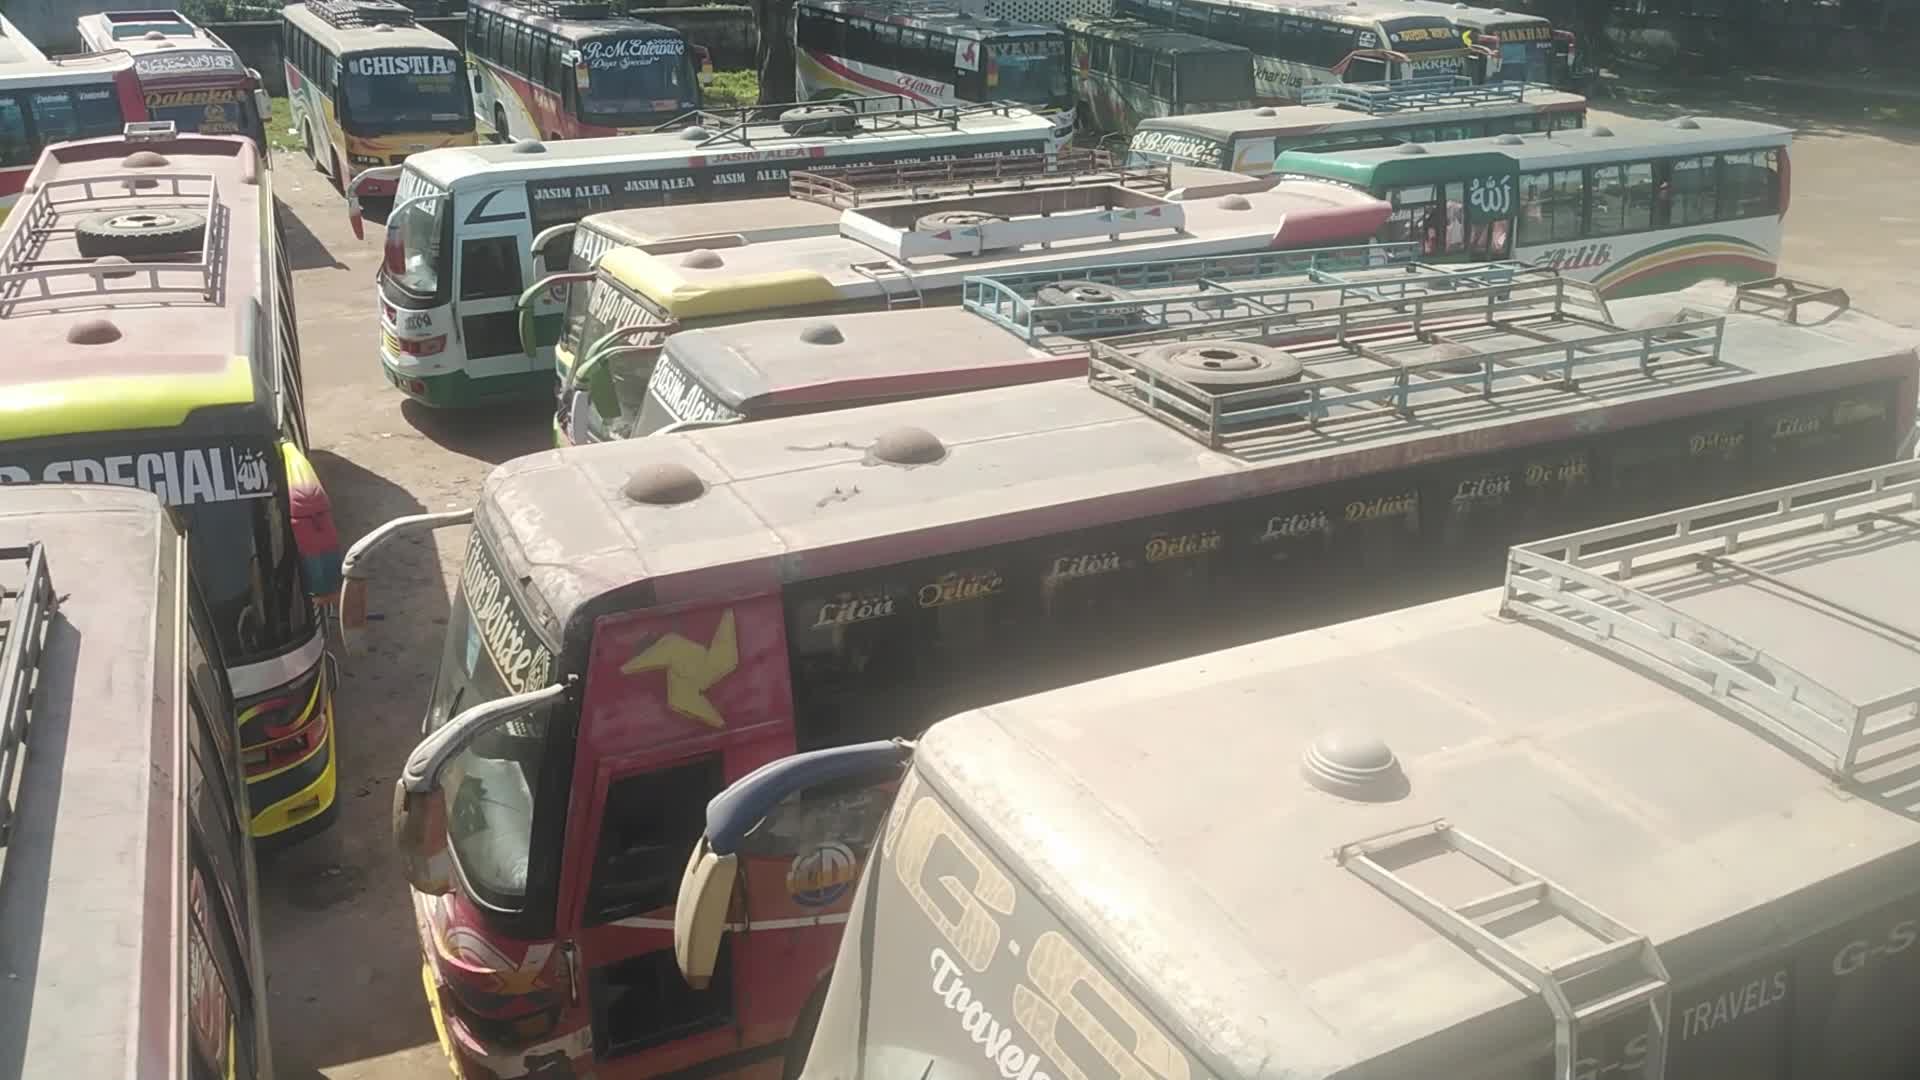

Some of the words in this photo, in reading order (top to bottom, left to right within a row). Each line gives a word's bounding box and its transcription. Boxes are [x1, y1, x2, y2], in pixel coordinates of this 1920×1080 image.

[359, 55, 449, 76] CHISTIA
[624, 179, 660, 192] JASIM
[661, 176, 695, 191] ALEA
[713, 172, 746, 185] JASIM
[757, 169, 788, 181] ALEA
[534, 187, 572, 201] JASIM
[575, 183, 611, 196] ALEA
[1681, 970, 1788, 1040] TRAVELS
